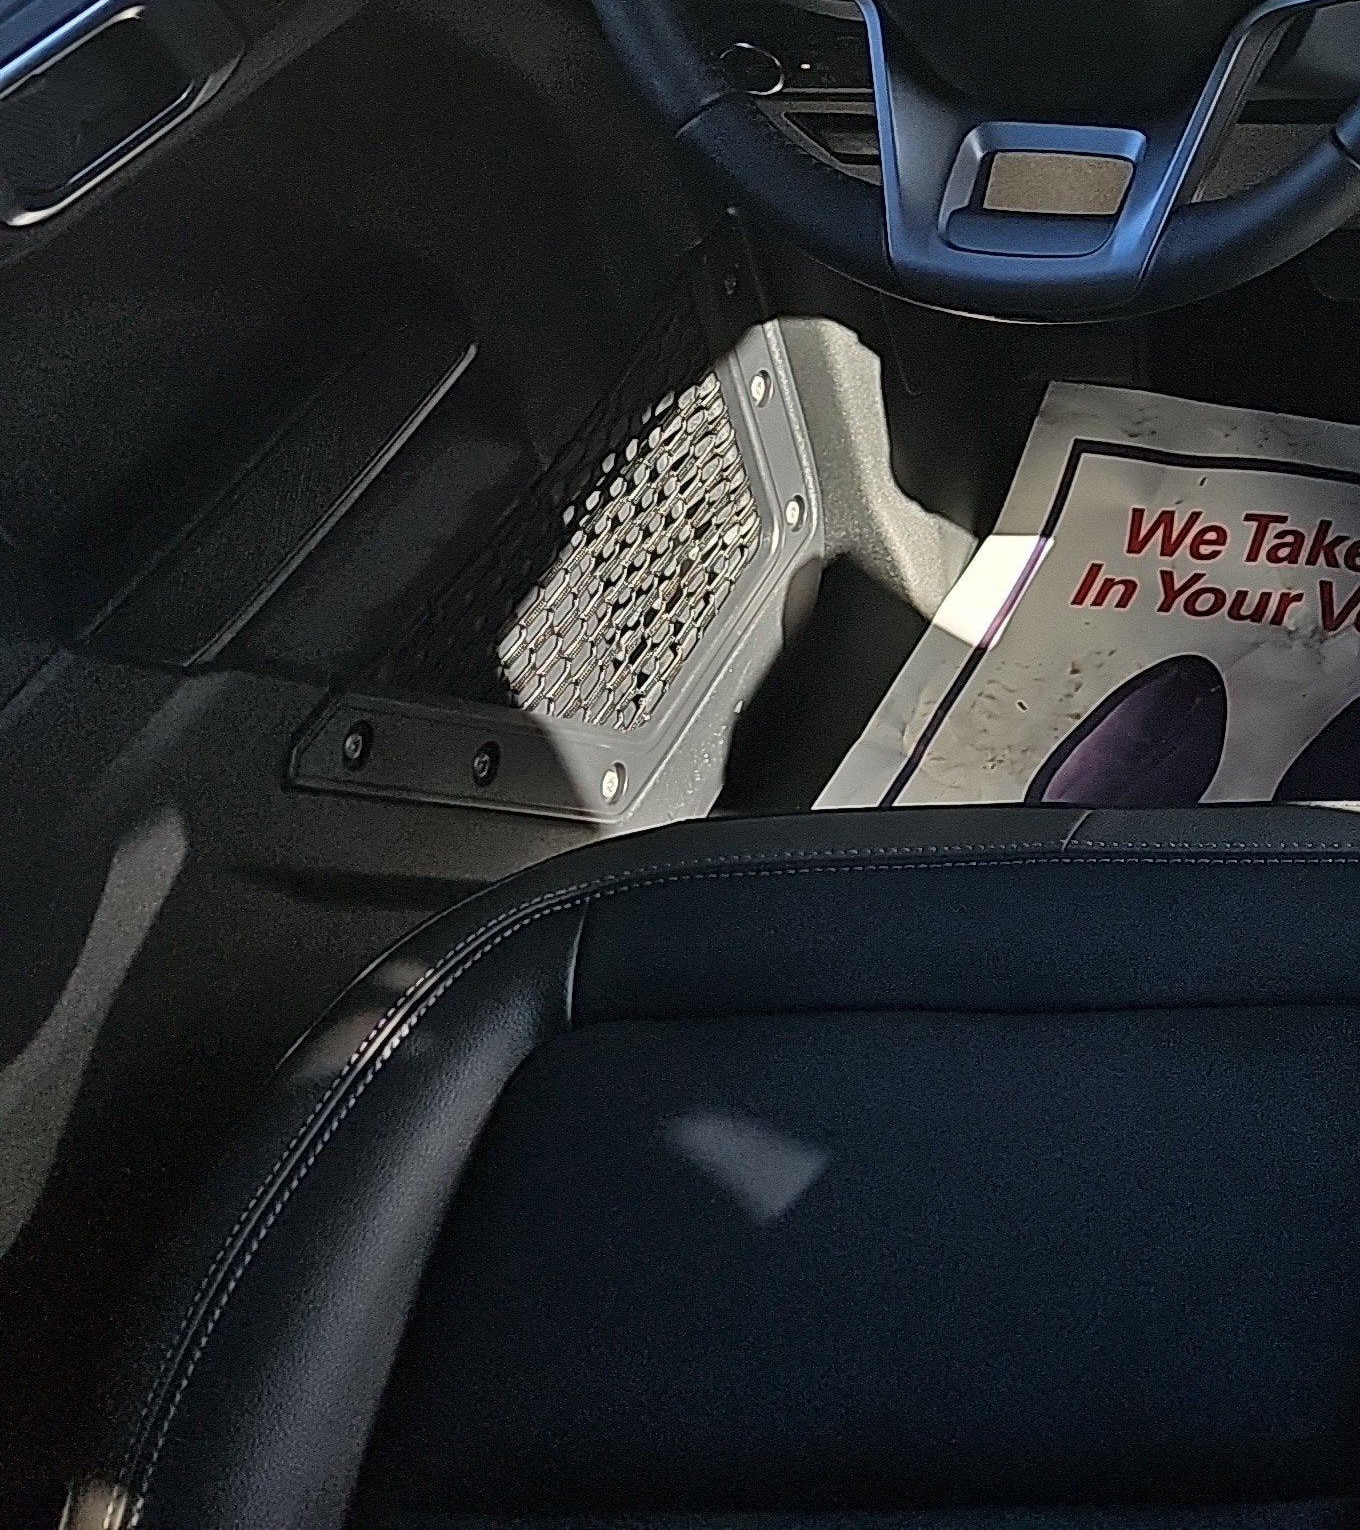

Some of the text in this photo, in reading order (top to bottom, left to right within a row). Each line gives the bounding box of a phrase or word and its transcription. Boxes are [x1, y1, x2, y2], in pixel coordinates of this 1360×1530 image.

[1125, 506, 1230, 561] We
[1069, 562, 1140, 609] In
[1156, 569, 1305, 627] Your
